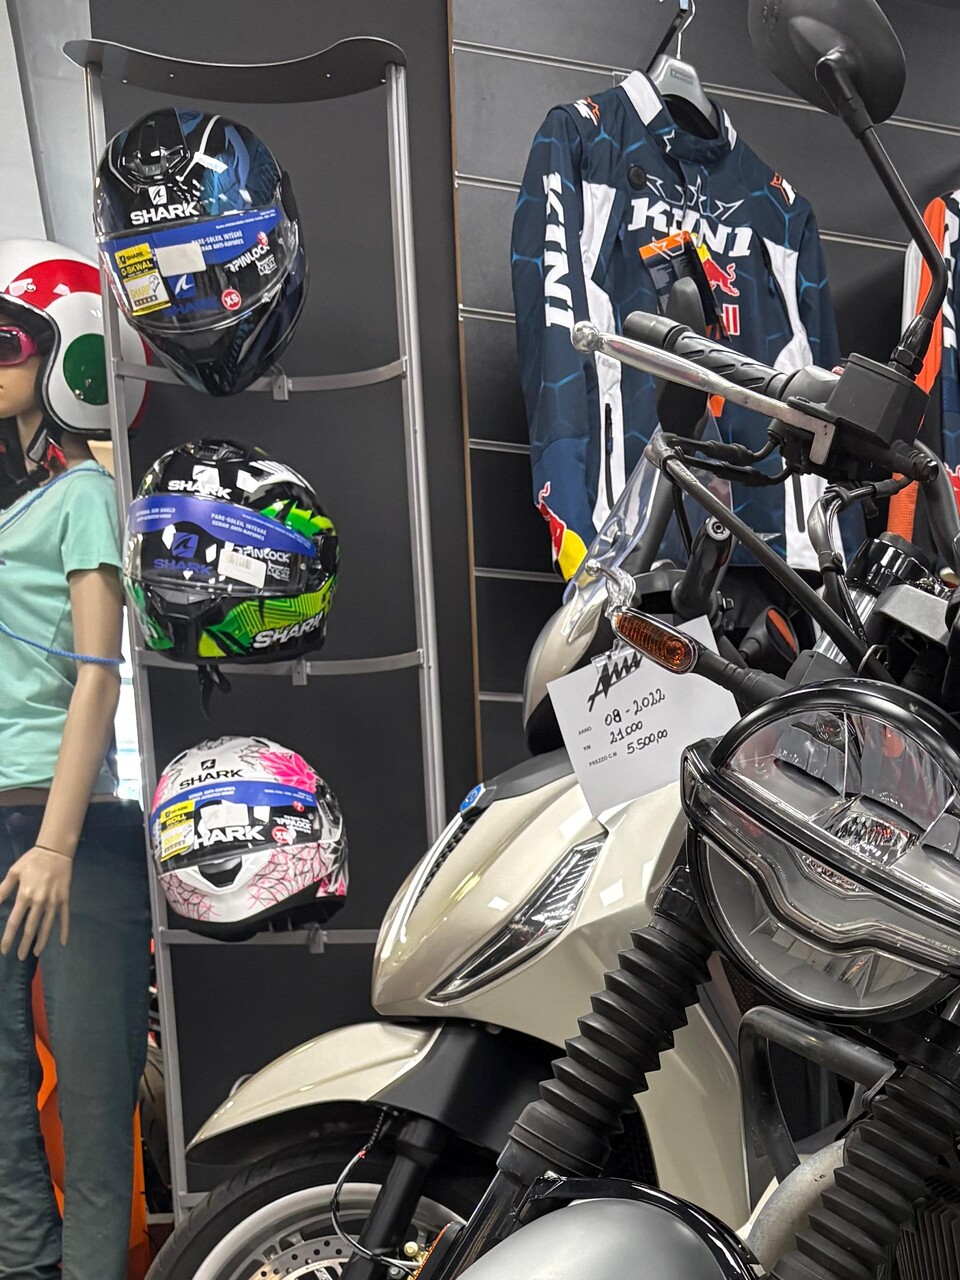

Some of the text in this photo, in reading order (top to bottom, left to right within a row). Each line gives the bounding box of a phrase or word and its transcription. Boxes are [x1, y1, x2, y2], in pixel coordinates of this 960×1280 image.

[130, 201, 200, 225] SHARK
[234, 245, 270, 271] PINLOCK
[542, 171, 574, 328] KINI
[224, 293, 239, 307] XS
[168, 480, 232, 499] SHARK
[153, 559, 214, 575] SHARK
[253, 611, 323, 649] SHARK
[578, 726, 592, 735] ANNO
[605, 708, 622, 726] 08
[633, 688, 665, 716] 2022
[589, 755, 608, 767] PREZZO
[179, 769, 243, 790] SHARK
[188, 826, 265, 853] HARK
